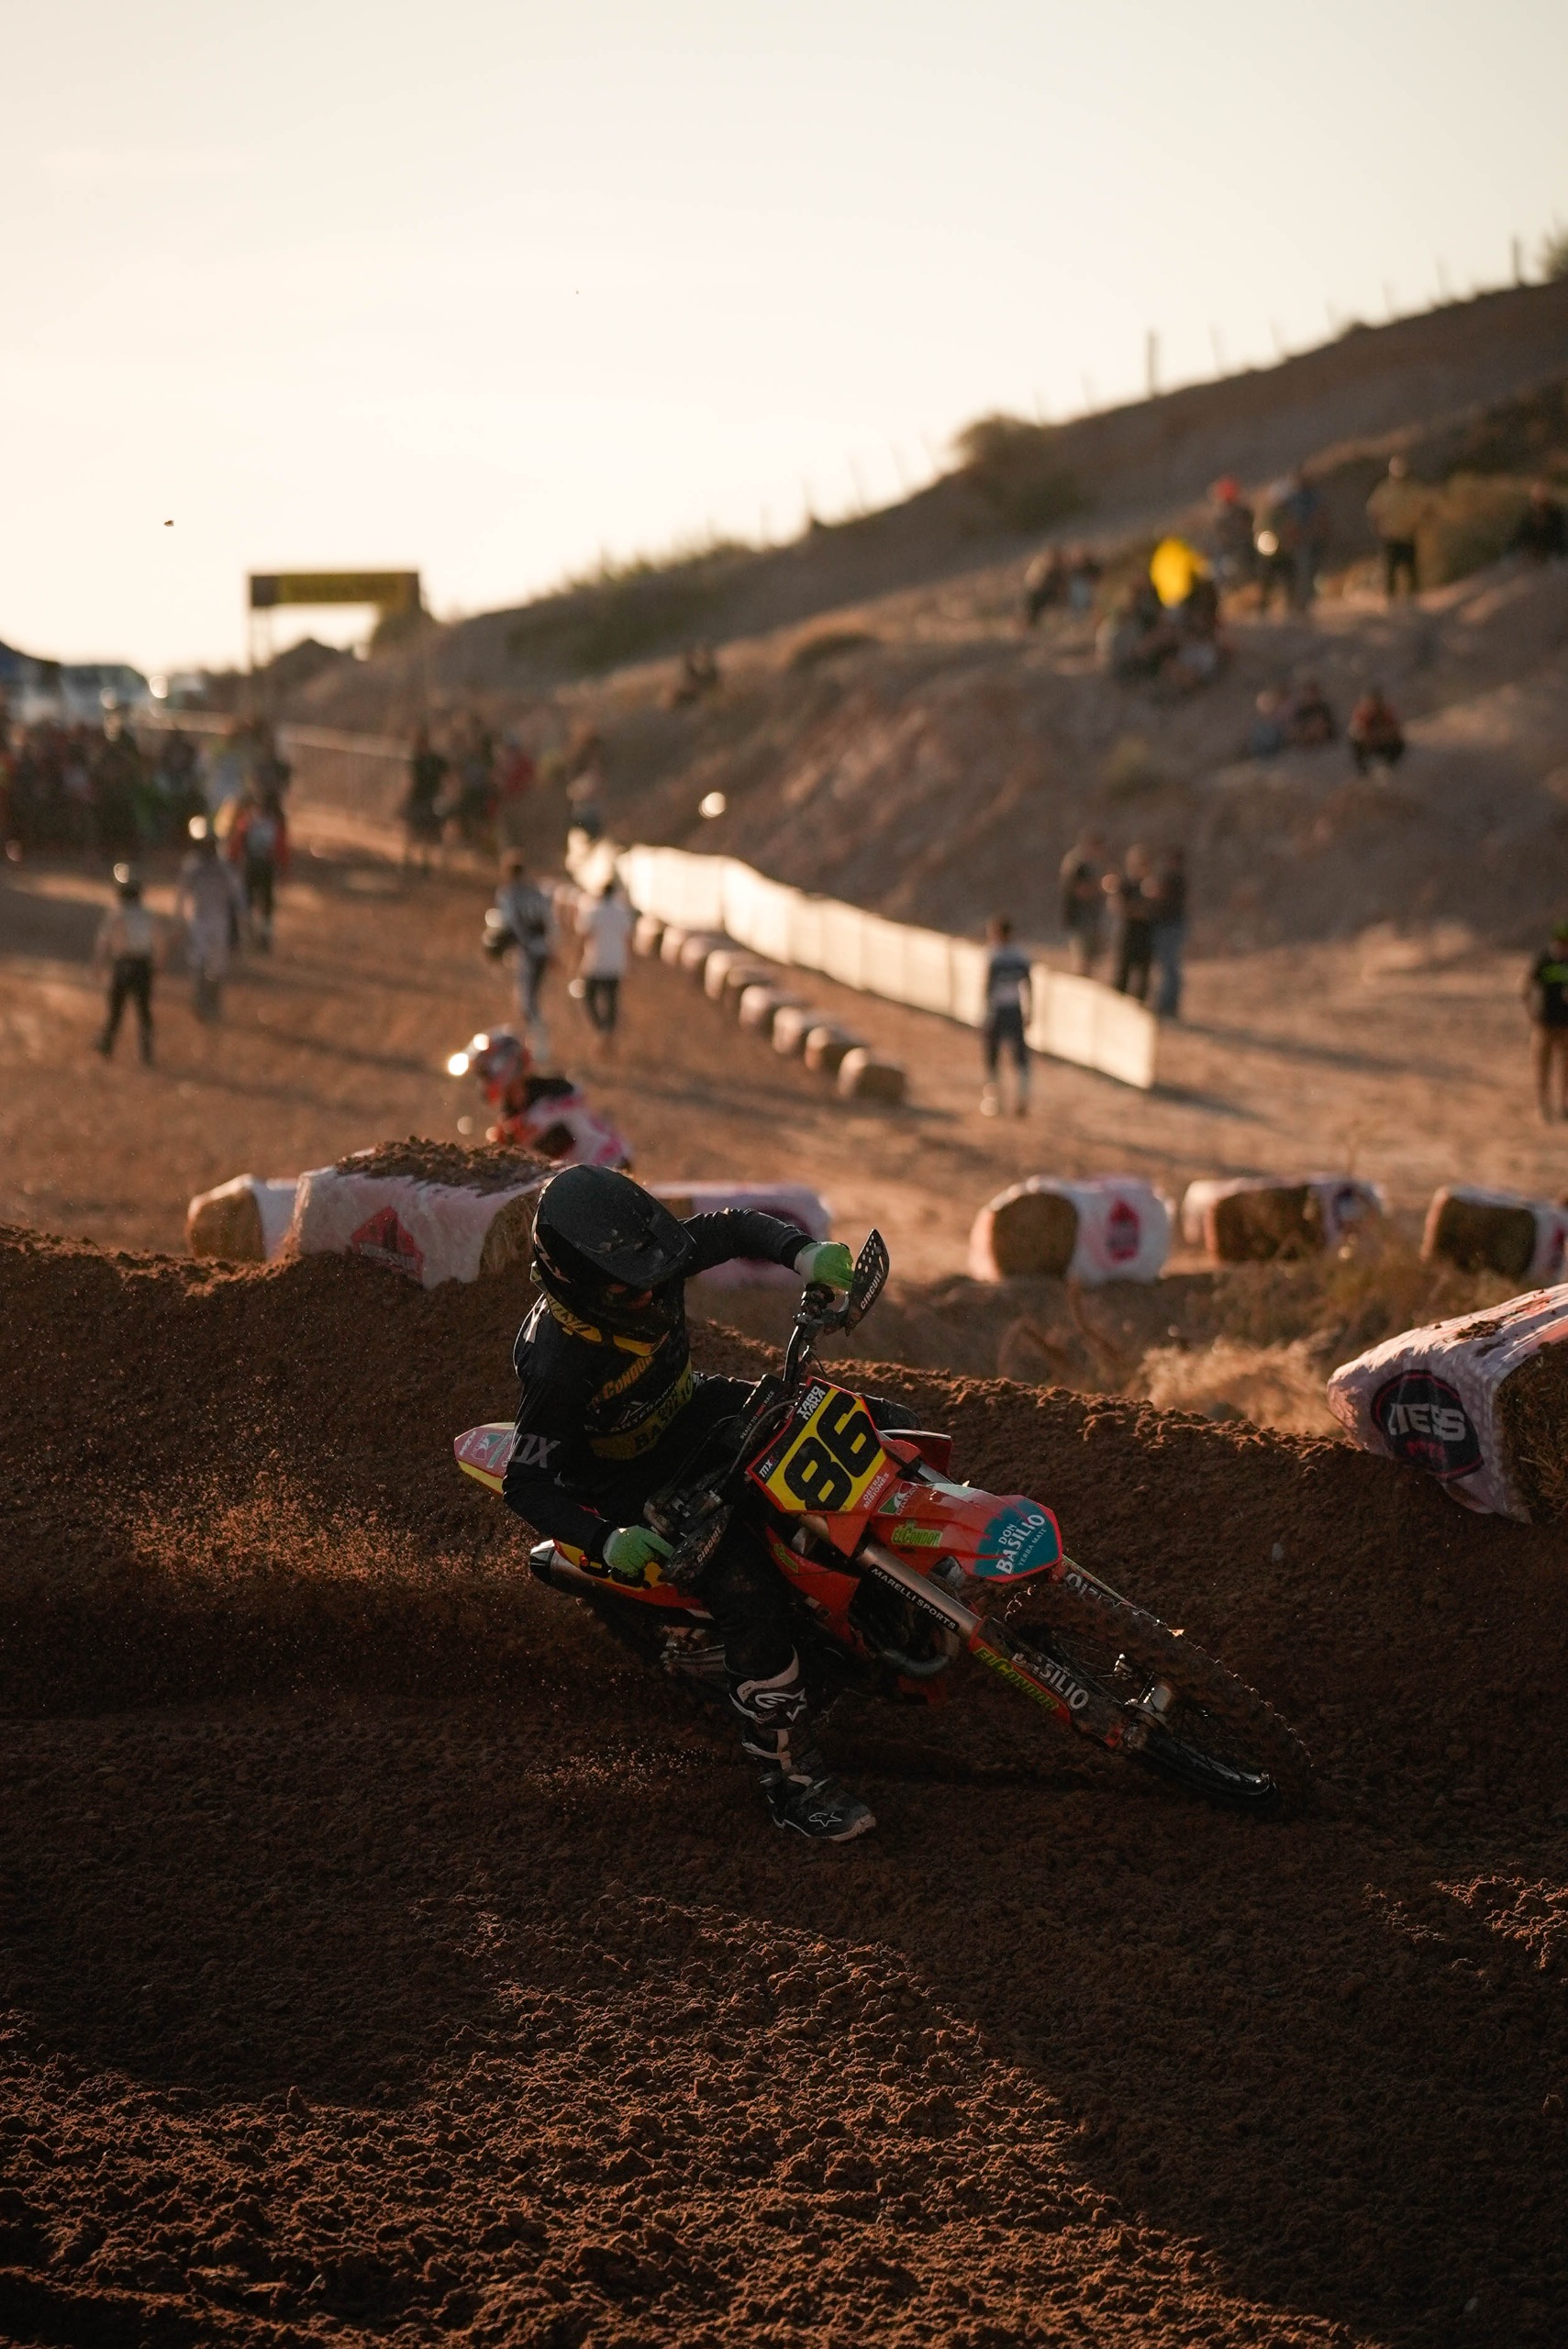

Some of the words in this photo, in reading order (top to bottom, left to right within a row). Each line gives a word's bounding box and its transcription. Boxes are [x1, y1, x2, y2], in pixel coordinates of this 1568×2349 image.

[796, 1385, 821, 1416] TARO
[784, 1390, 882, 1511] 86
[863, 1472, 890, 1509] MISIONES
[995, 1514, 1045, 1575] BASILIO
[998, 1523, 1018, 1545] DON
[1018, 1544, 1034, 1566] YERBA
[1031, 1527, 1047, 1544] MATE
[871, 1567, 917, 1602] MARELLI
[917, 1598, 956, 1630] SPORTS
